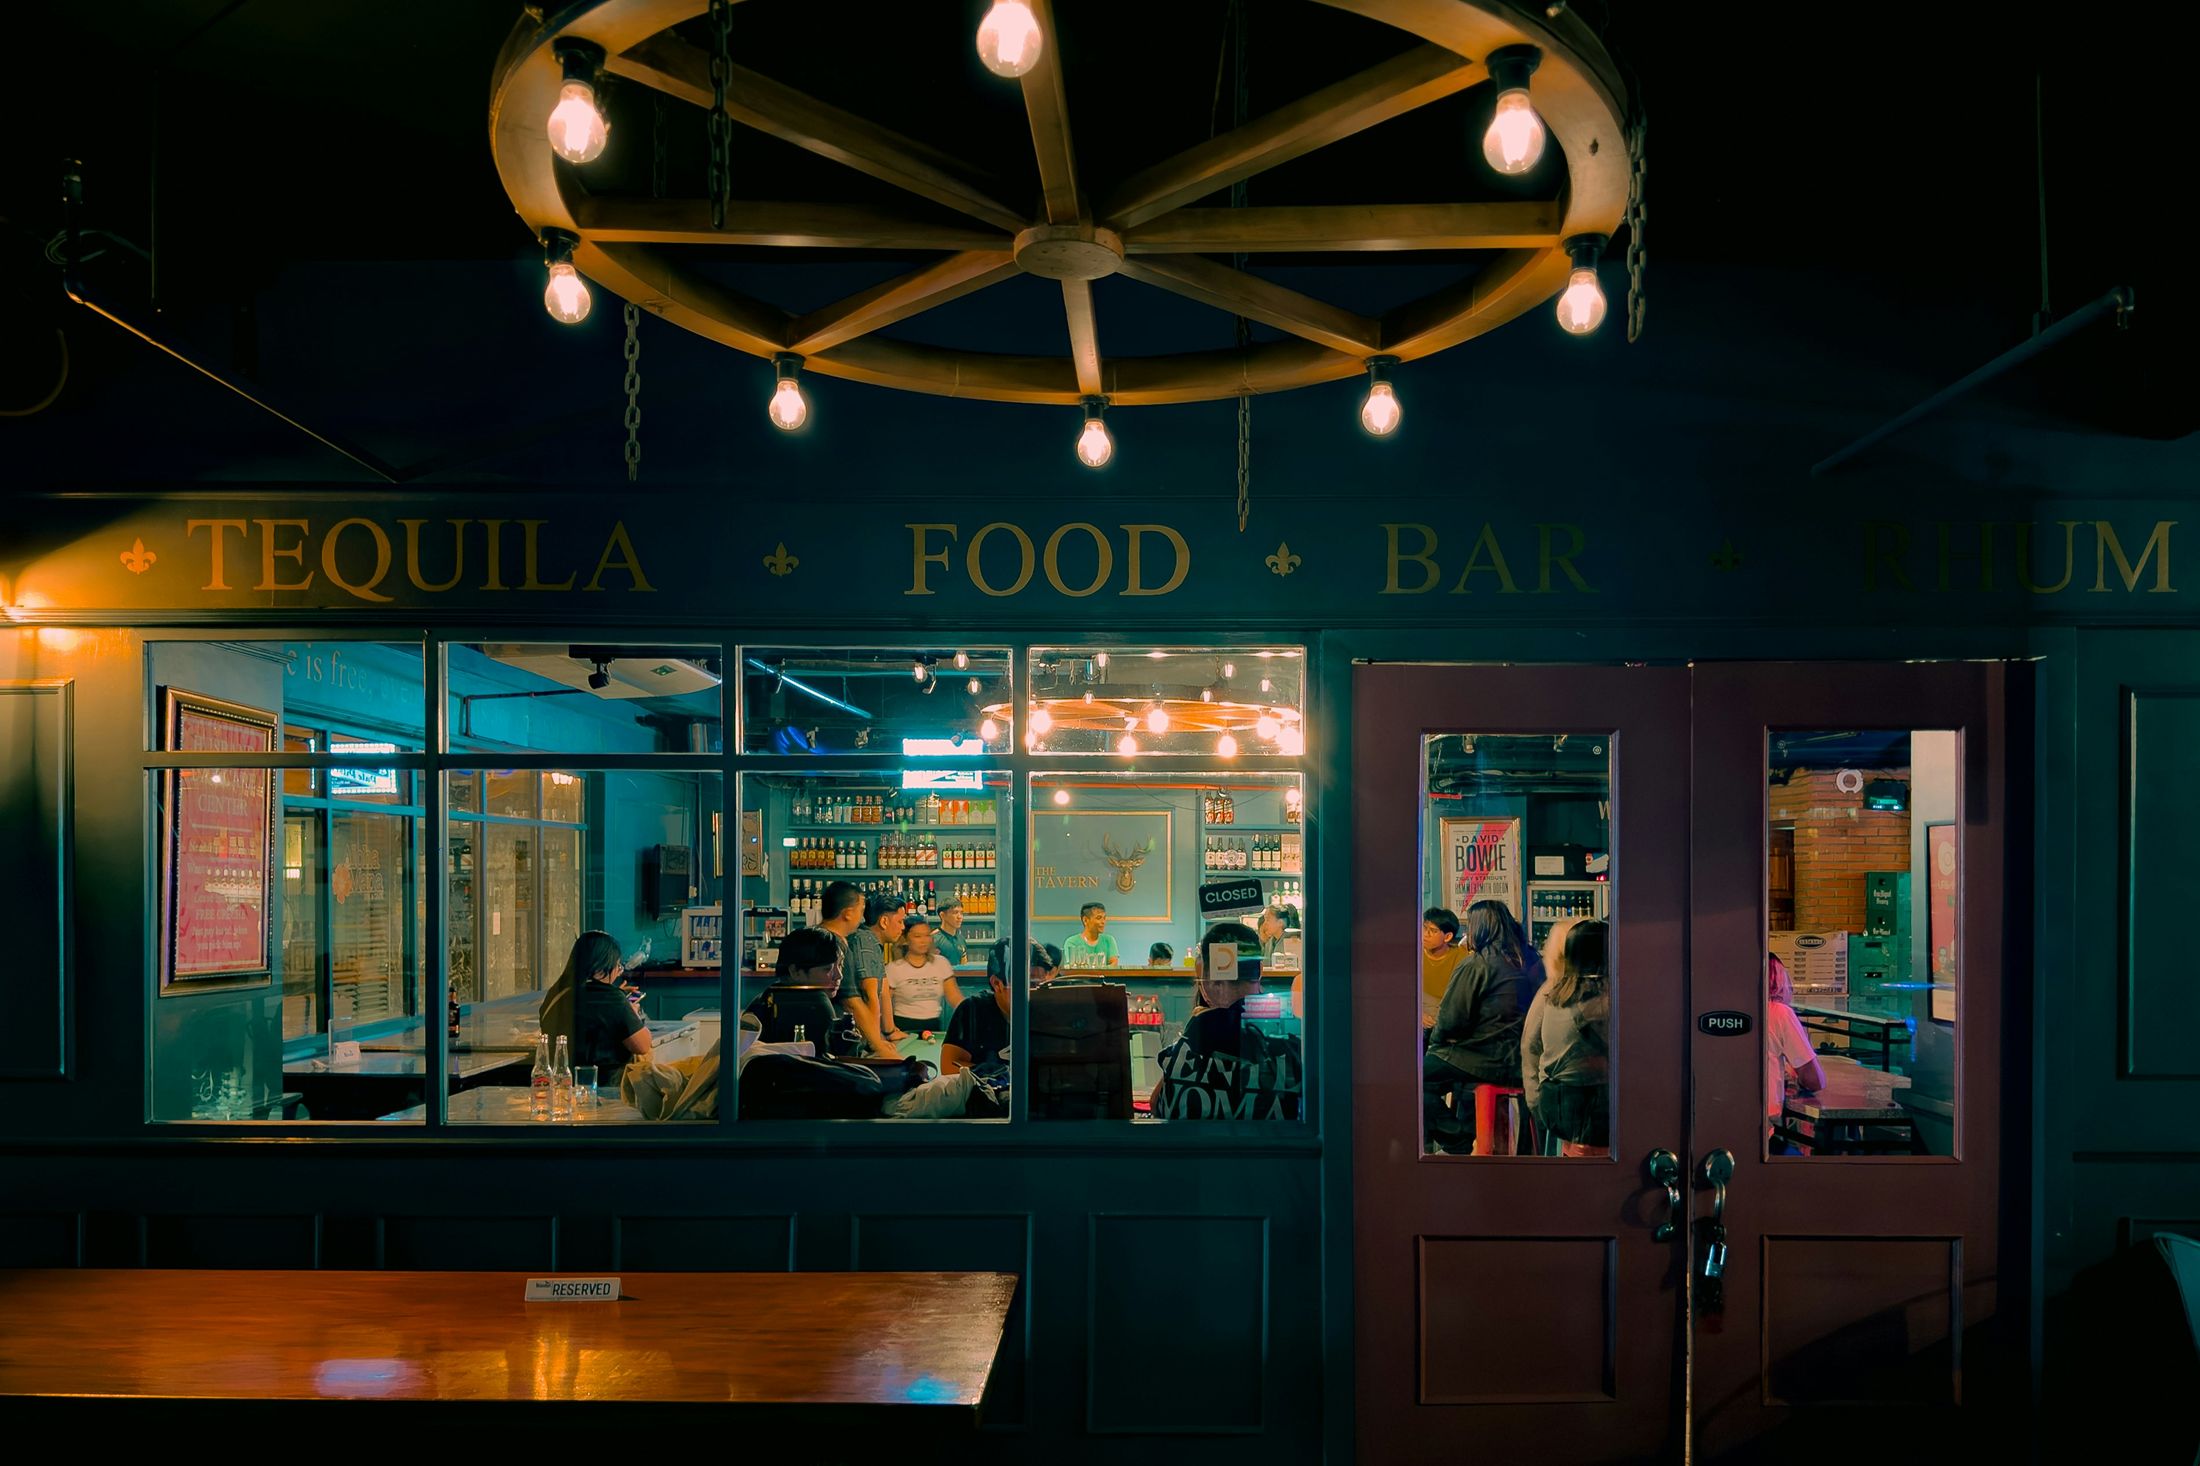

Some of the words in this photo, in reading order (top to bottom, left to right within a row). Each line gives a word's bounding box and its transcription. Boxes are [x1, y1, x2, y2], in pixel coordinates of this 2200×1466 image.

[187, 517, 657, 603] TEQUILA
[904, 522, 1191, 598] FOOD
[1378, 522, 1600, 596] BAR
[1856, 519, 2179, 595] RHUM
[198, 793, 248, 817] CENTER
[1462, 835, 1499, 843] DAVID
[1455, 844, 1507, 872] BOWIE
[1036, 866, 1056, 875] THE
[1036, 876, 1099, 888] TAVERN
[1205, 887, 1258, 904] CLOSED
[1708, 1017, 1743, 1029] PUSH
[552, 1282, 611, 1297] RESERVED
